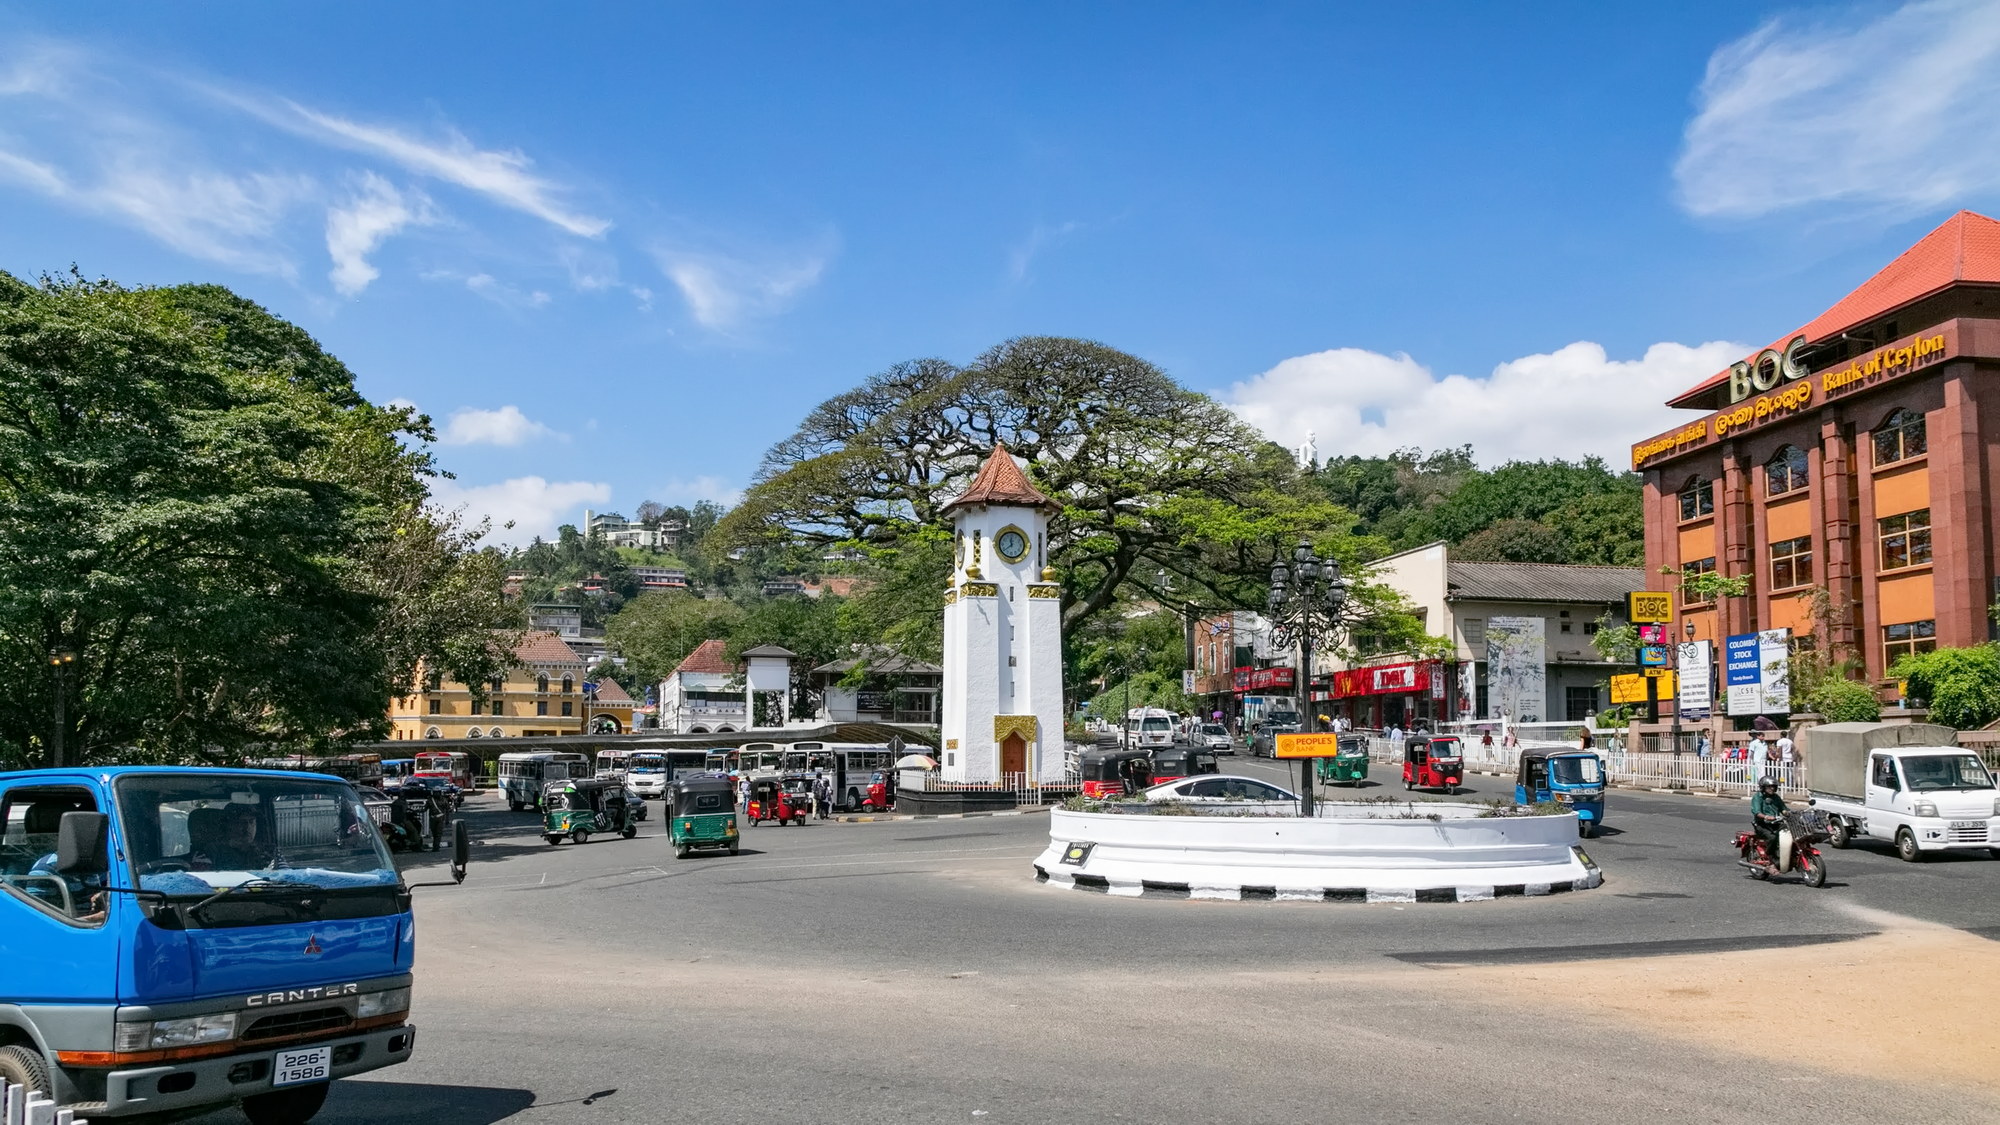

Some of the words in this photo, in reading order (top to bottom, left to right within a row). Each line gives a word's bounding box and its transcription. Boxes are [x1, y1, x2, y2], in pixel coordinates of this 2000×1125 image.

[1730, 334, 1810, 404] BOC
[1822, 361, 1864, 392] Bank
[1864, 351, 1882, 376] of
[1883, 335, 1946, 368] Ceylon
[1636, 600, 1669, 615] BOC
[1729, 639, 1757, 649] COLOMBO
[1733, 650, 1753, 660] STOCK
[1728, 660, 1758, 671] EXCHANGE
[1296, 737, 1333, 745] PEOPLE'S
[246, 983, 358, 1007] CANTER
[284, 1053, 326, 1068] 226-
[280, 1066, 325, 1082] 1586
